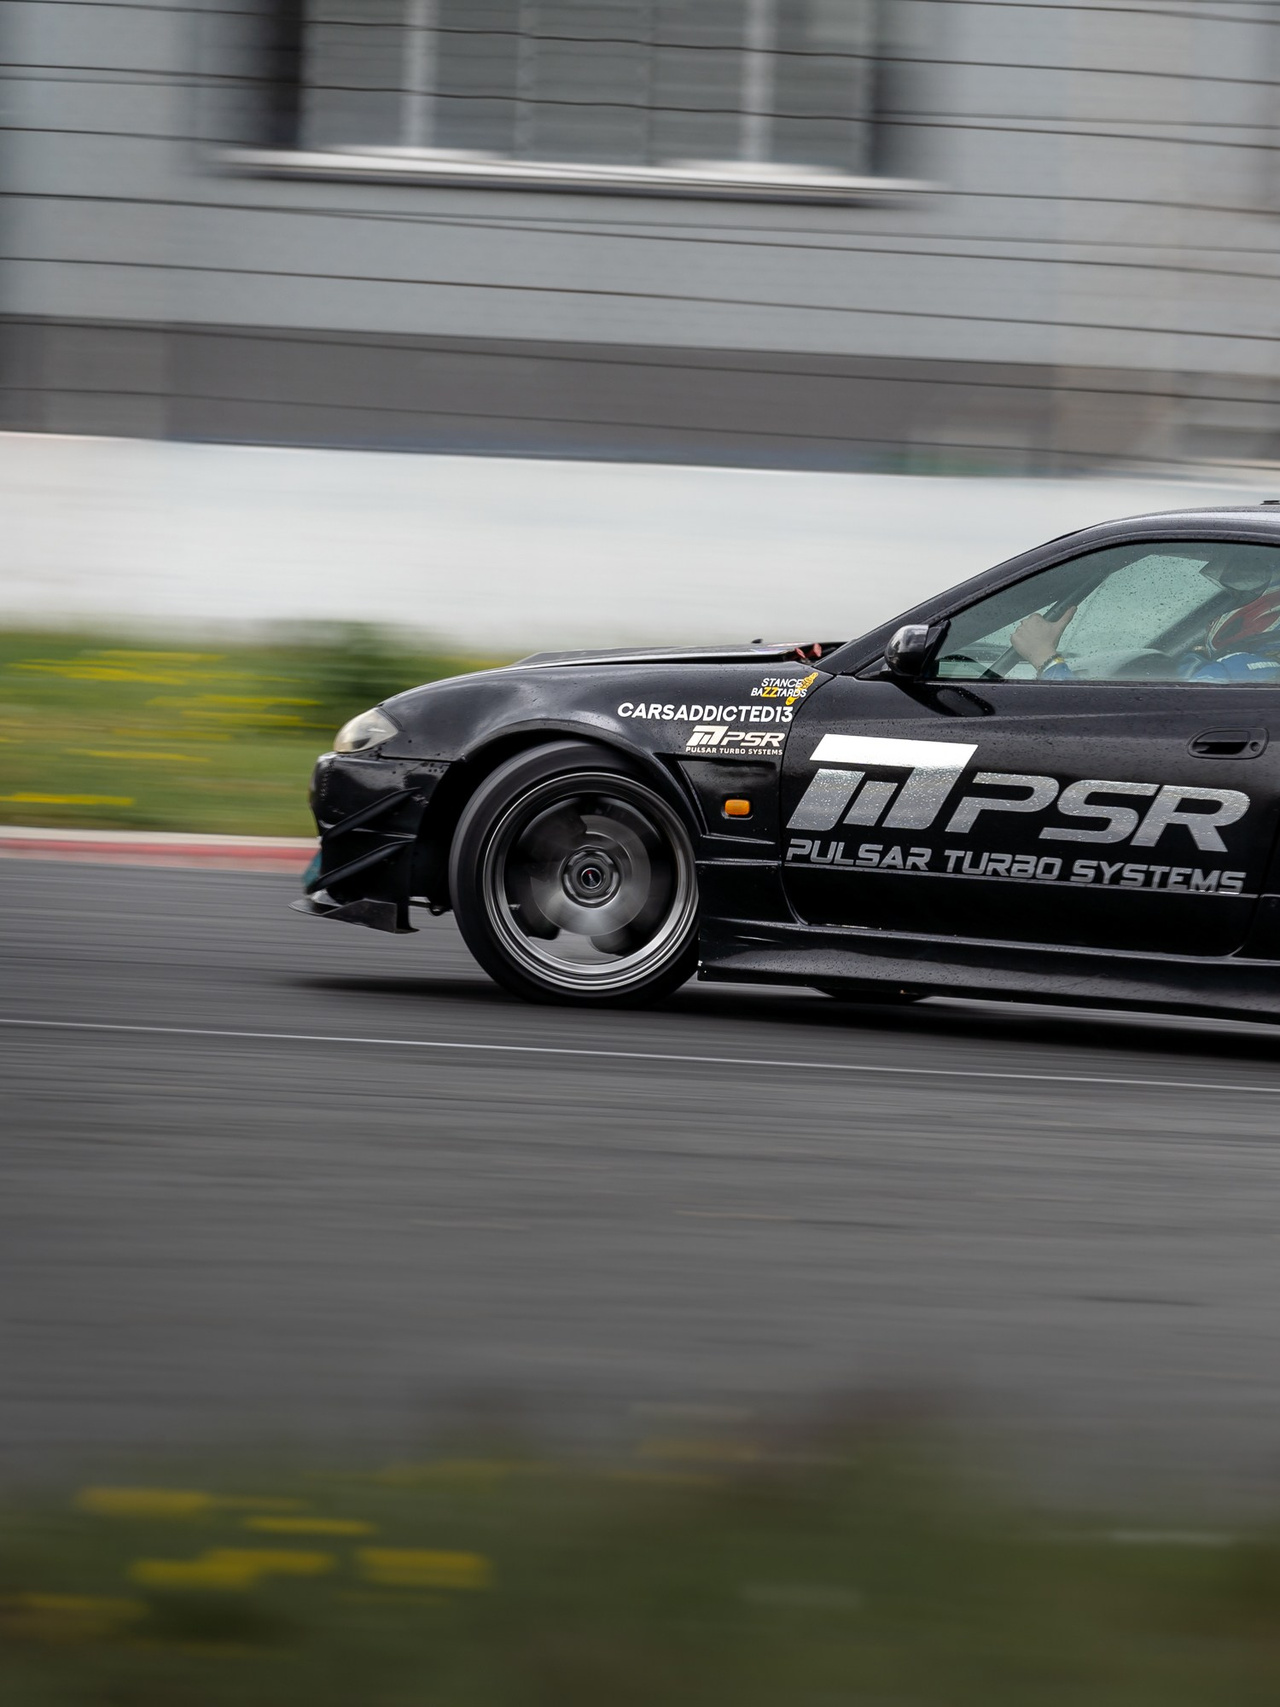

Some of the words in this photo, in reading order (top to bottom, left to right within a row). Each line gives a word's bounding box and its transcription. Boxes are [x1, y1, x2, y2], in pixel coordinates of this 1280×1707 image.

[761, 678, 805, 688] STANCE
[751, 686, 807, 698] BAZZTARDS
[617, 702, 793, 722] CARSADDICTED13
[720, 731, 785, 747] PSR
[686, 746, 717, 754] PULSAR
[944, 772, 1251, 852] PSR
[786, 839, 932, 871] PULSAR
[944, 849, 1064, 880] TURBO
[1069, 859, 1246, 895] SYSTEMS
